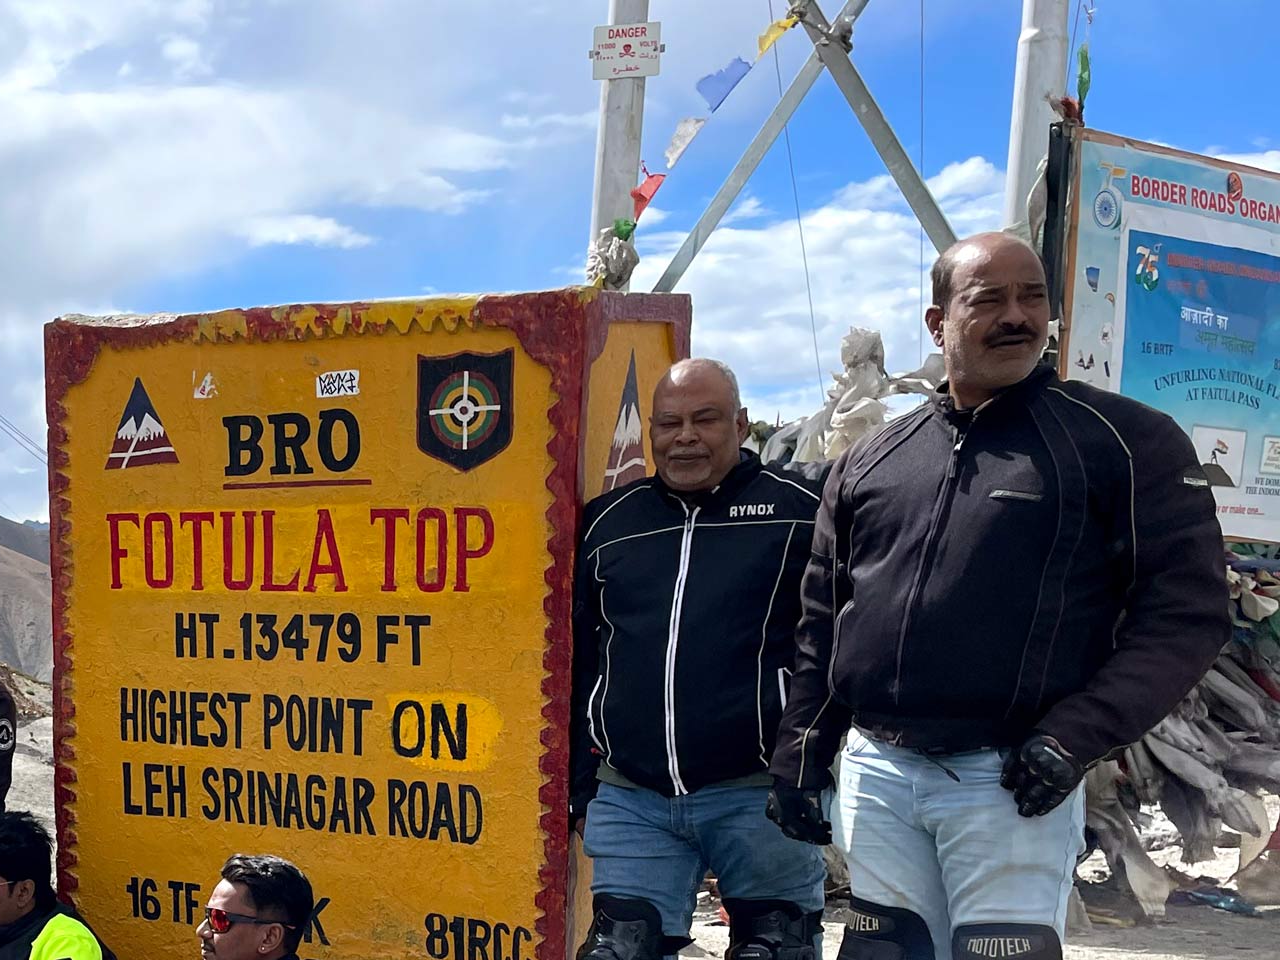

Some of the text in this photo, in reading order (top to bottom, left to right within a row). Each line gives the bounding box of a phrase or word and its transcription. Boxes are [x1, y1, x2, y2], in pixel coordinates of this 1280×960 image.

[608, 27, 647, 39] DANGER
[1131, 175, 1187, 206] BORDER
[1191, 187, 1236, 215] ROADS
[1141, 341, 1174, 356] 16 BRTF
[1154, 367, 1217, 391] UNFURLING
[1219, 368, 1264, 393] NATIONAL
[1185, 388, 1200, 401] AT
[1237, 391, 1261, 410] PASS
[223, 408, 360, 476] BRO
[729, 504, 775, 518] RYNOX
[106, 507, 494, 593] FOTULA TOP
[376, 615, 430, 666] FT
[120, 688, 468, 760] HIGHEST POINT ON
[122, 762, 483, 845] LEH SRINAGAR ROAD
[127, 877, 161, 921] 16
[967, 937, 1031, 957] MOTOTECH
